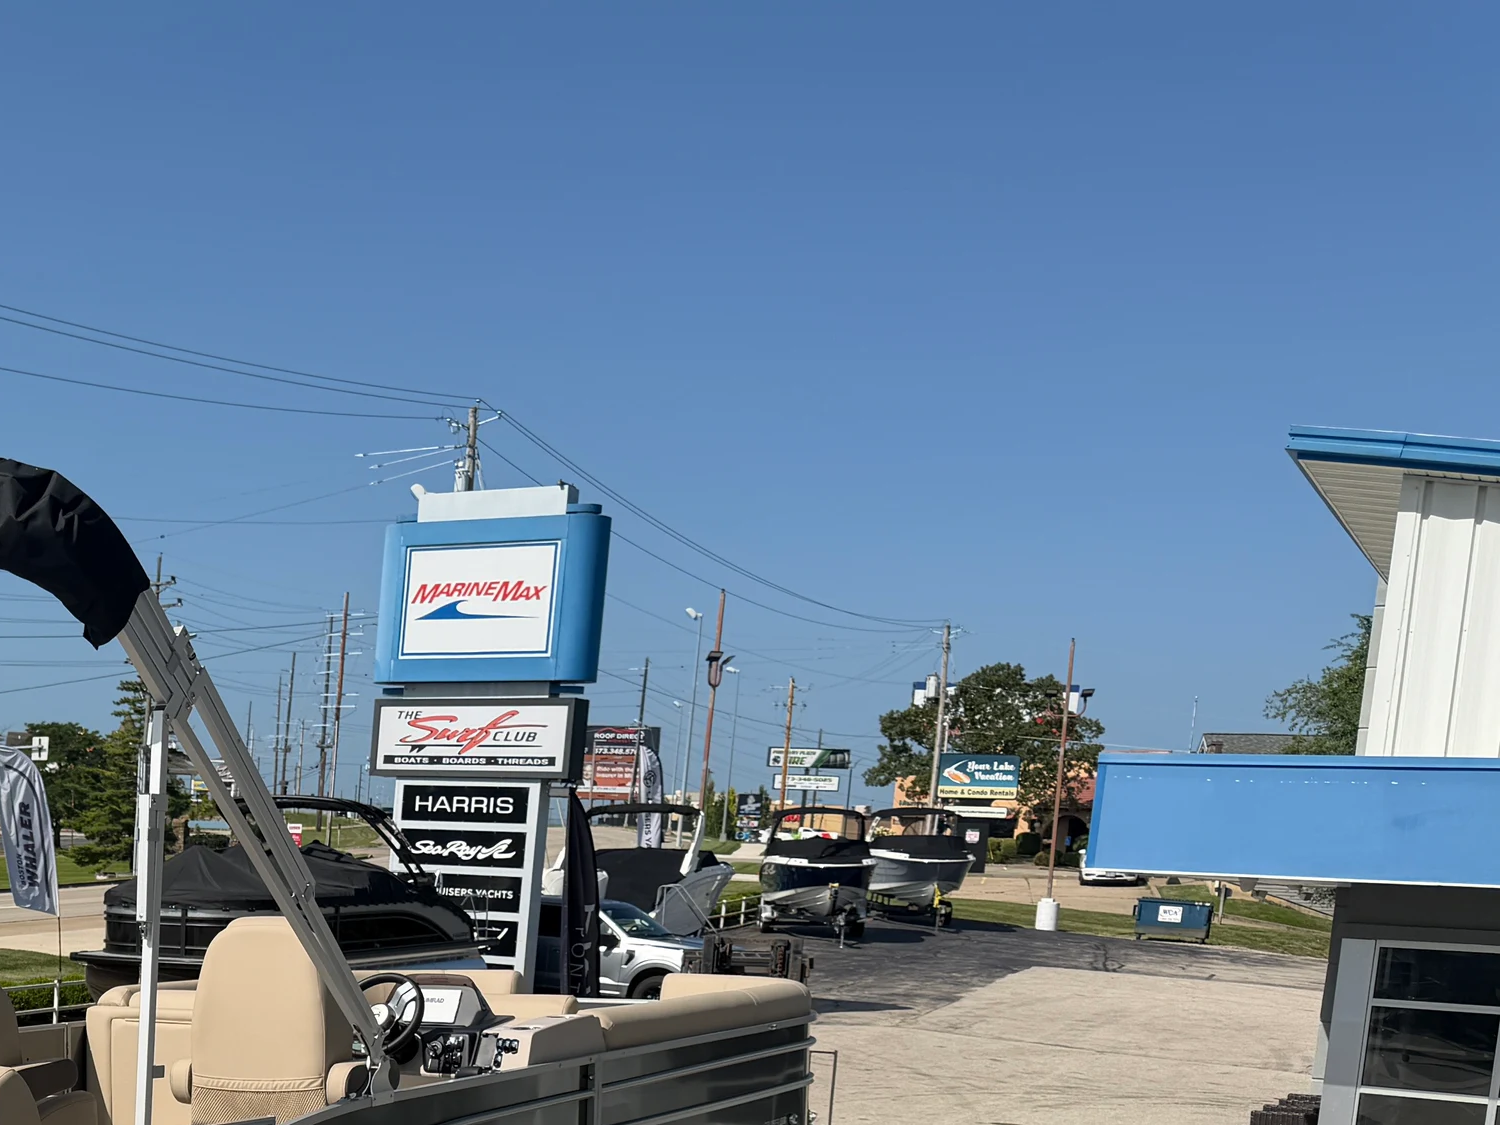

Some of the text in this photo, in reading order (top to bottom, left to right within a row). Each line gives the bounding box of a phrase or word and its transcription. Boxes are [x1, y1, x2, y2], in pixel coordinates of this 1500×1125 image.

[397, 710, 422, 720] THE
[399, 709, 548, 755] Surf
[492, 731, 538, 743] CLUB
[442, 757, 487, 765] BOARDS
[496, 758, 549, 766] THREADS
[993, 761, 1016, 771] Lake
[414, 795, 514, 814] HARRIS
[19, 801, 39, 887] WHALER
